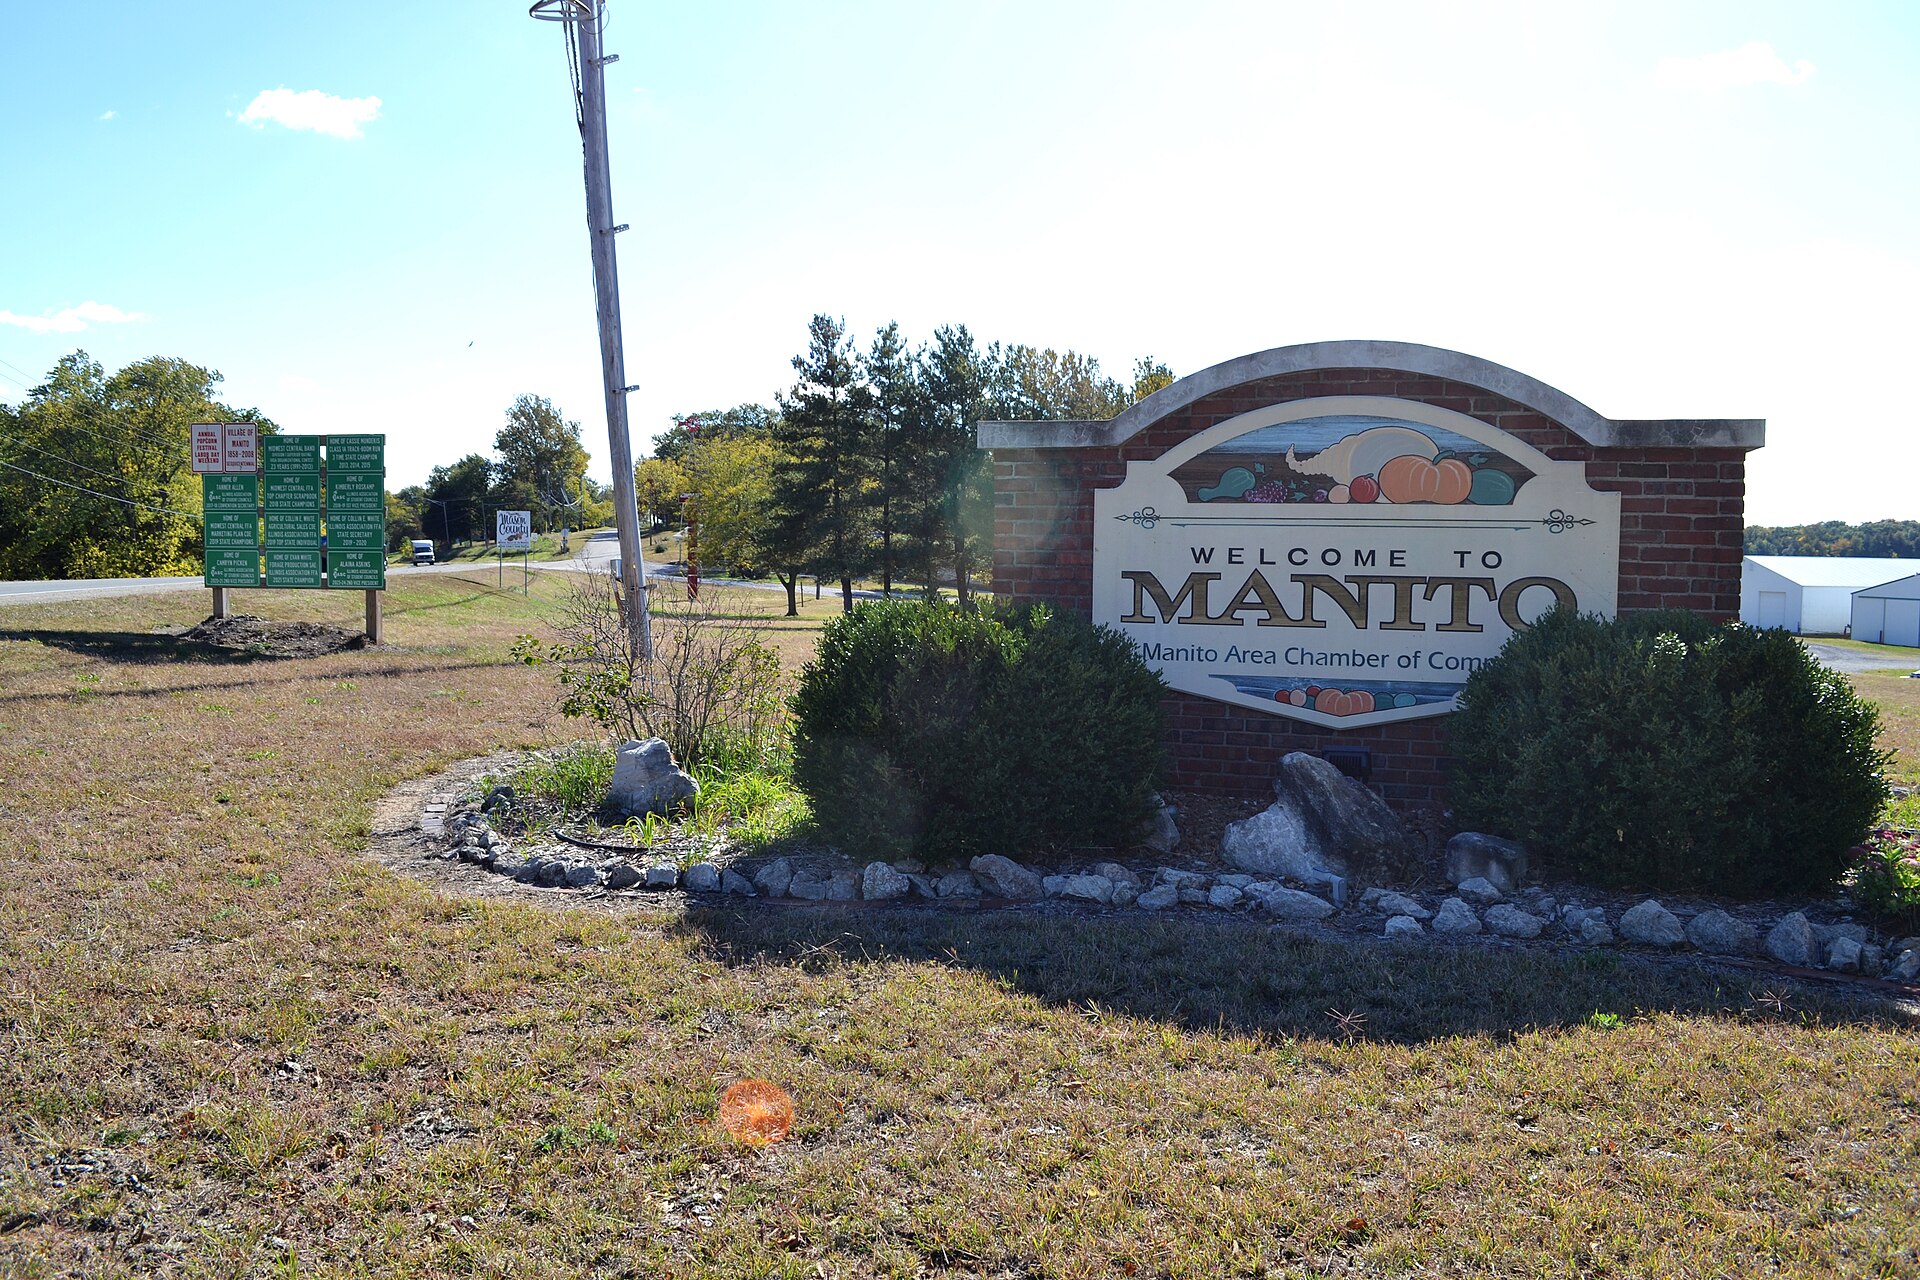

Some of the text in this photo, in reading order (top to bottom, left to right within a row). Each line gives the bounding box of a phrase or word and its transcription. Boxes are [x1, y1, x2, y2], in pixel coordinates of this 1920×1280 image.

[499, 513, 526, 524] Mason
[499, 524, 528, 538] County
[1191, 547, 1502, 569] WELCOME TO
[1120, 568, 1577, 633] MANITO
[1142, 642, 1217, 662] Manito
[1224, 645, 1276, 664] Area
[1284, 647, 1389, 668] Chamber
[1397, 650, 1421, 669] of
